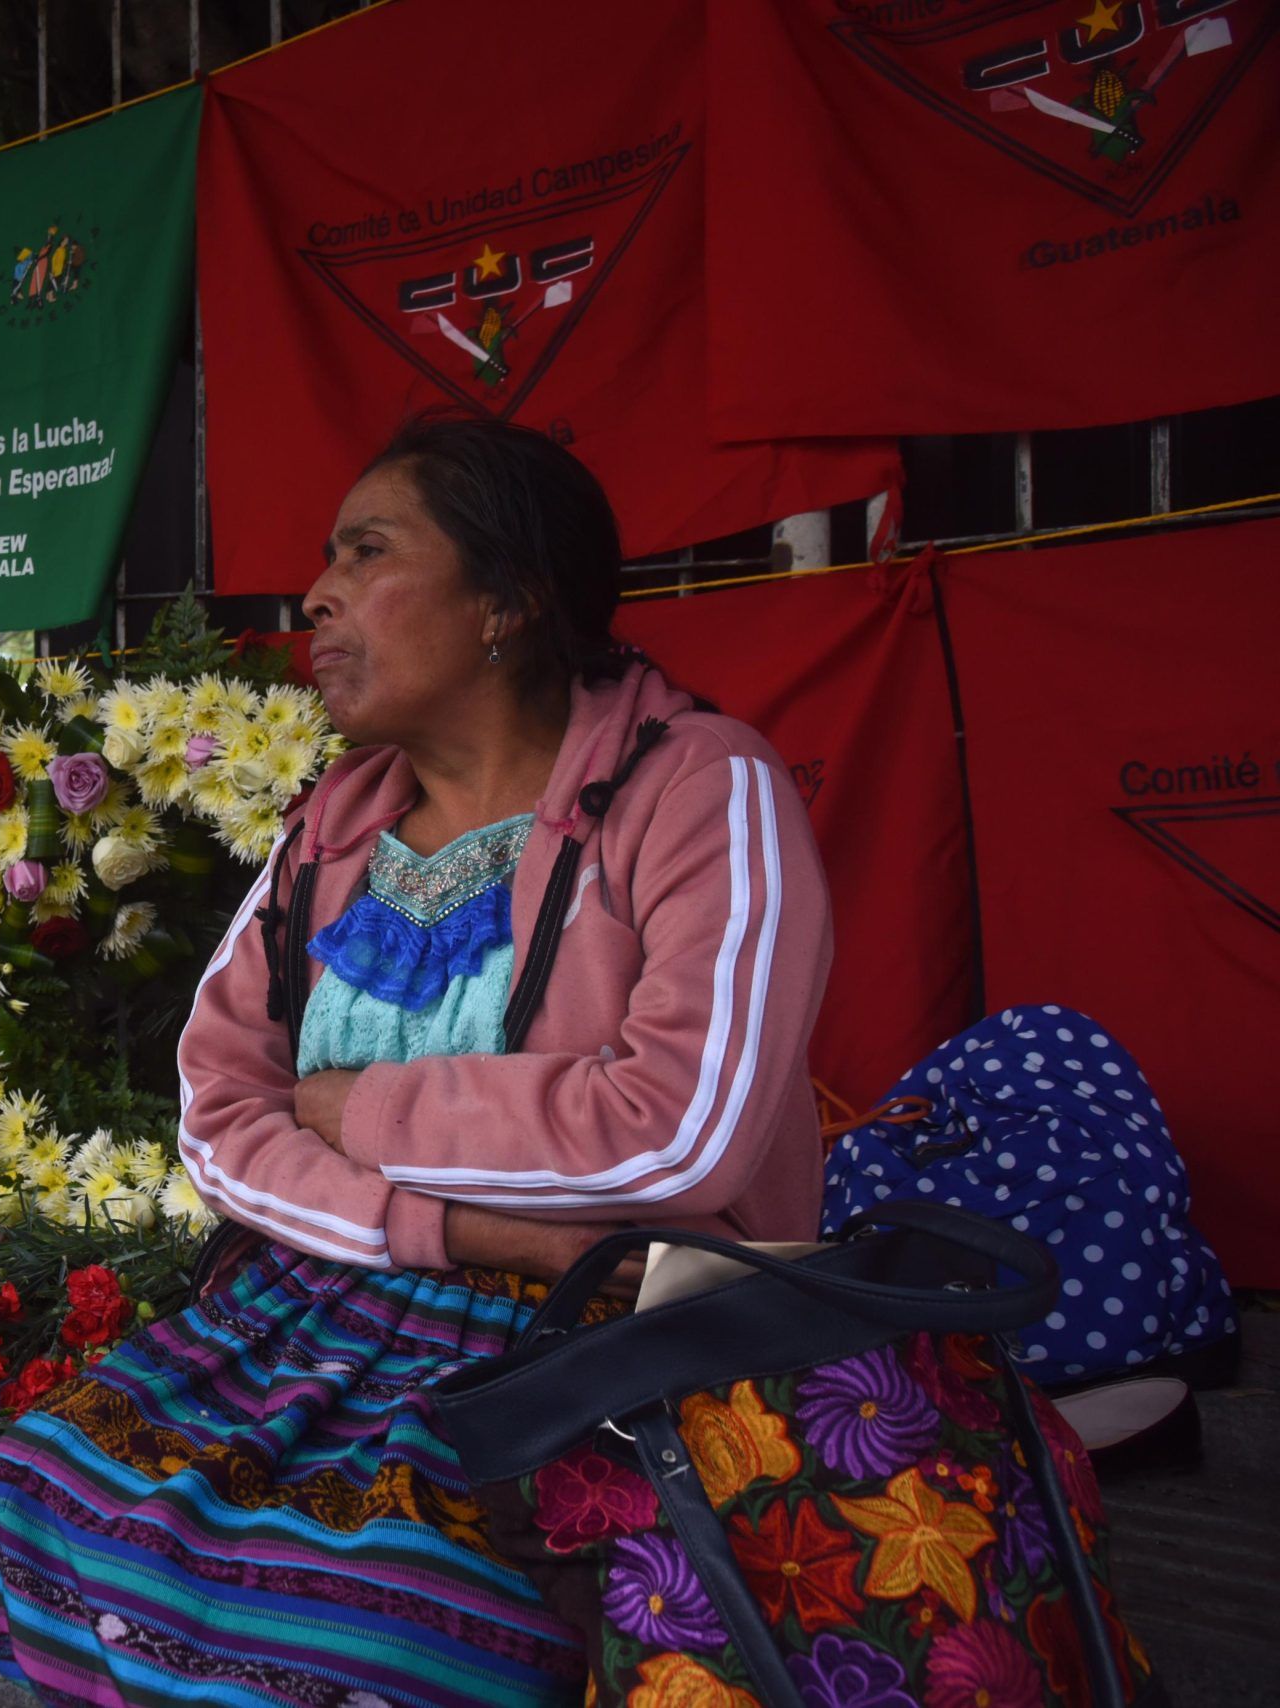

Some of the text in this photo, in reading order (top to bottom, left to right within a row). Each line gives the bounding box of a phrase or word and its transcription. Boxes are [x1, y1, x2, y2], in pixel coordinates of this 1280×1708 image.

[428, 176, 524, 226] Unidad
[1025, 193, 1241, 270] Guatemala
[399, 236, 595, 313] CUC
[12, 428, 29, 454] la
[34, 417, 104, 450] Lucha,
[8, 448, 116, 500] Esperanza!
[1121, 752, 1261, 796] Comité
